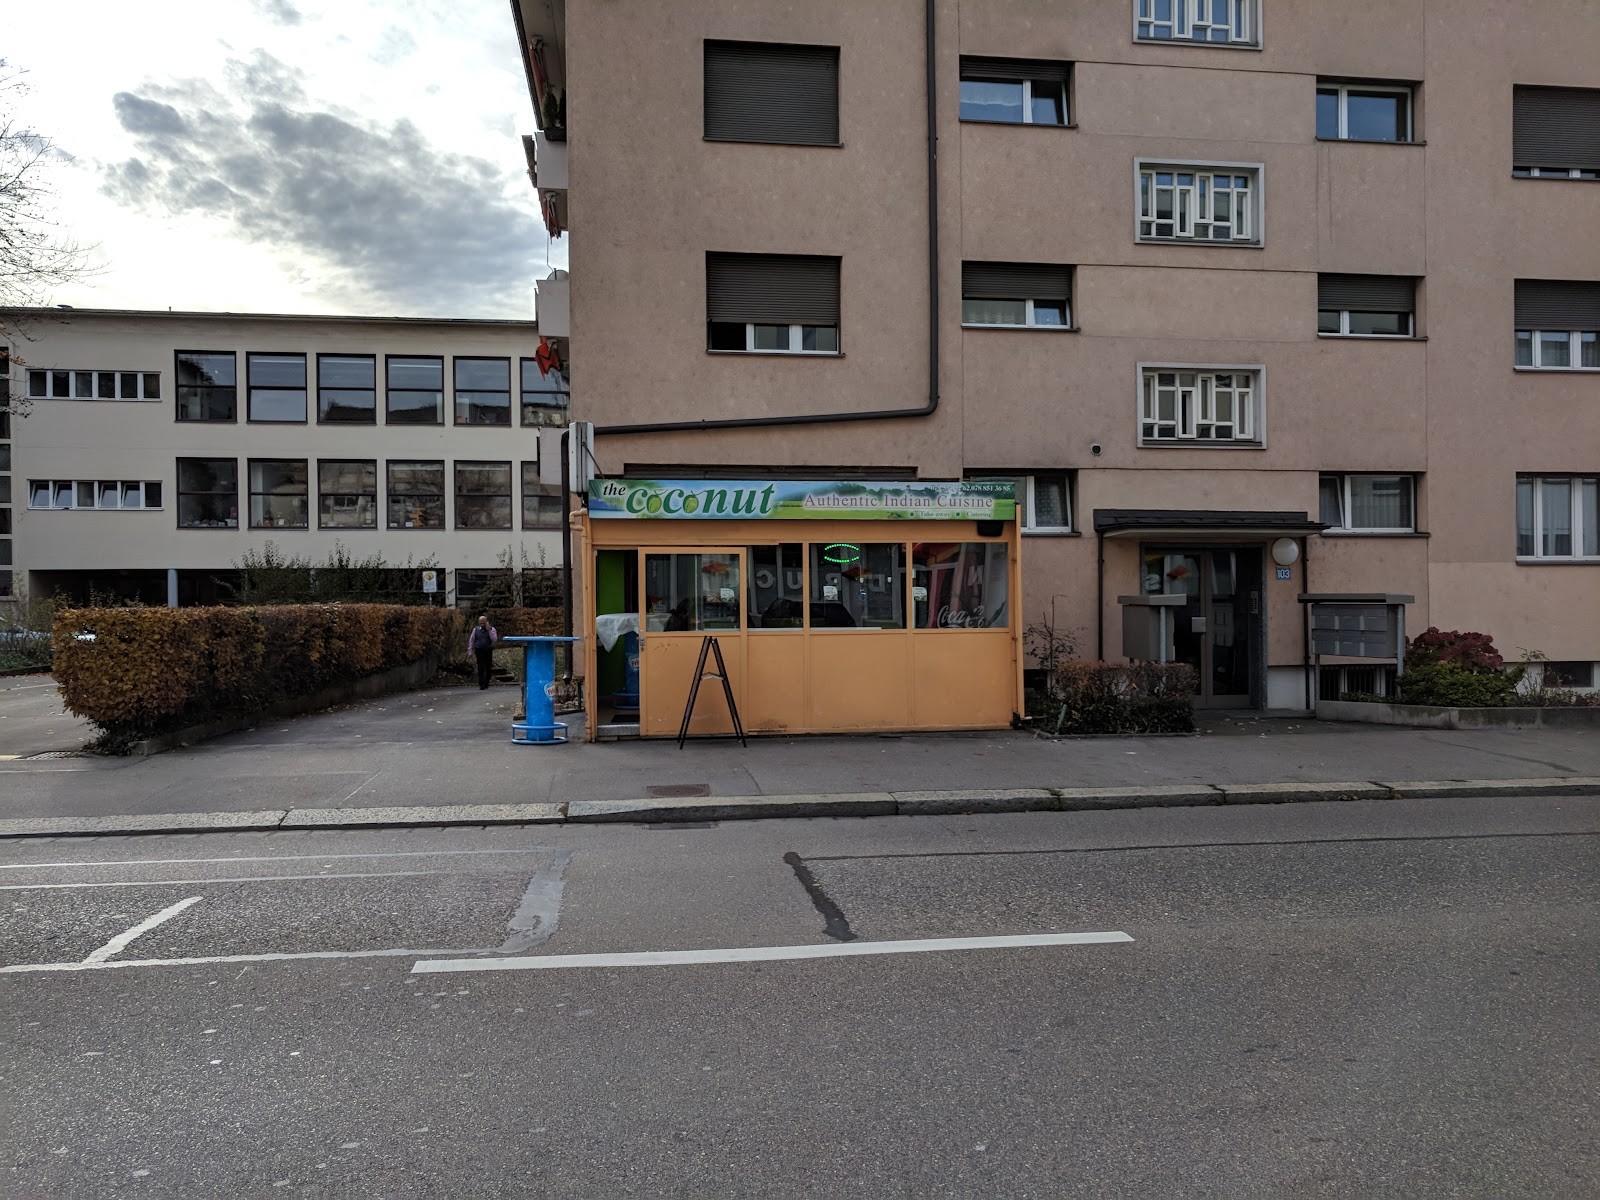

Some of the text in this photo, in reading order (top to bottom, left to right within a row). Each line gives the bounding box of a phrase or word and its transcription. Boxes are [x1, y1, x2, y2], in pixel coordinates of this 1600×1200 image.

[603, 483, 626, 496] the
[626, 483, 775, 514] coconut
[804, 494, 993, 508] Authentic Indian Cuisine
[1277, 569, 1290, 579] 103
